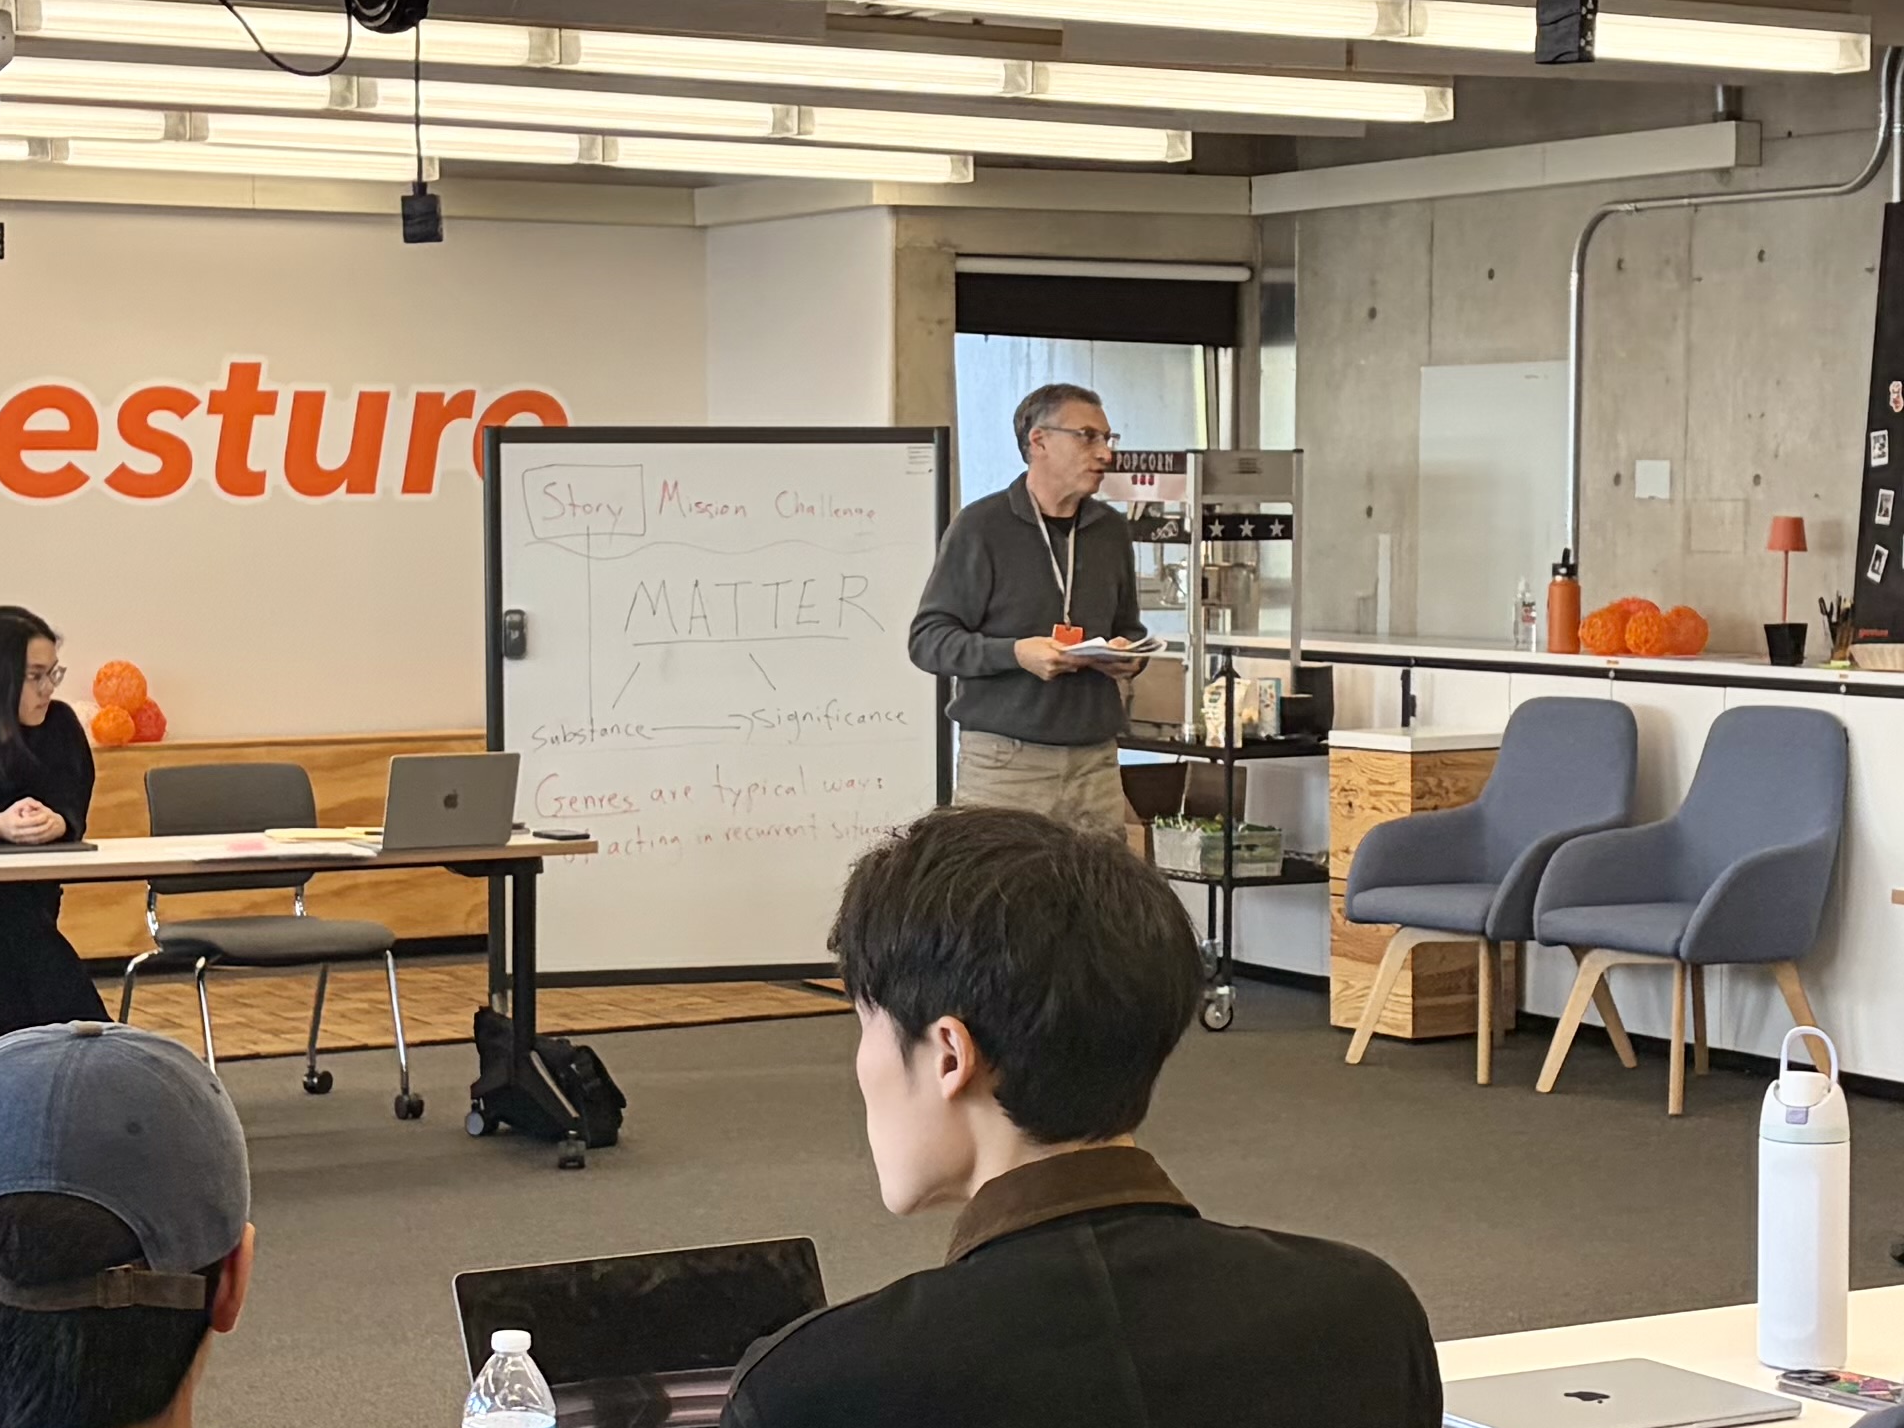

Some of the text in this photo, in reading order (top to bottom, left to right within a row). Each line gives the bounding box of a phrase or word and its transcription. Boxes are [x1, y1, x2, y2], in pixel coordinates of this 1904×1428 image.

[1116, 453, 1173, 471] POPCORN
[542, 479, 876, 539] Story Mission Challenge
[624, 573, 885, 637] MATTER
[531, 698, 908, 752] Substance Significance
[535, 773, 637, 818] Genres
[650, 785, 696, 805] are
[712, 764, 806, 814] typical
[607, 825, 681, 860] acting
[725, 812, 818, 843] recurrent
